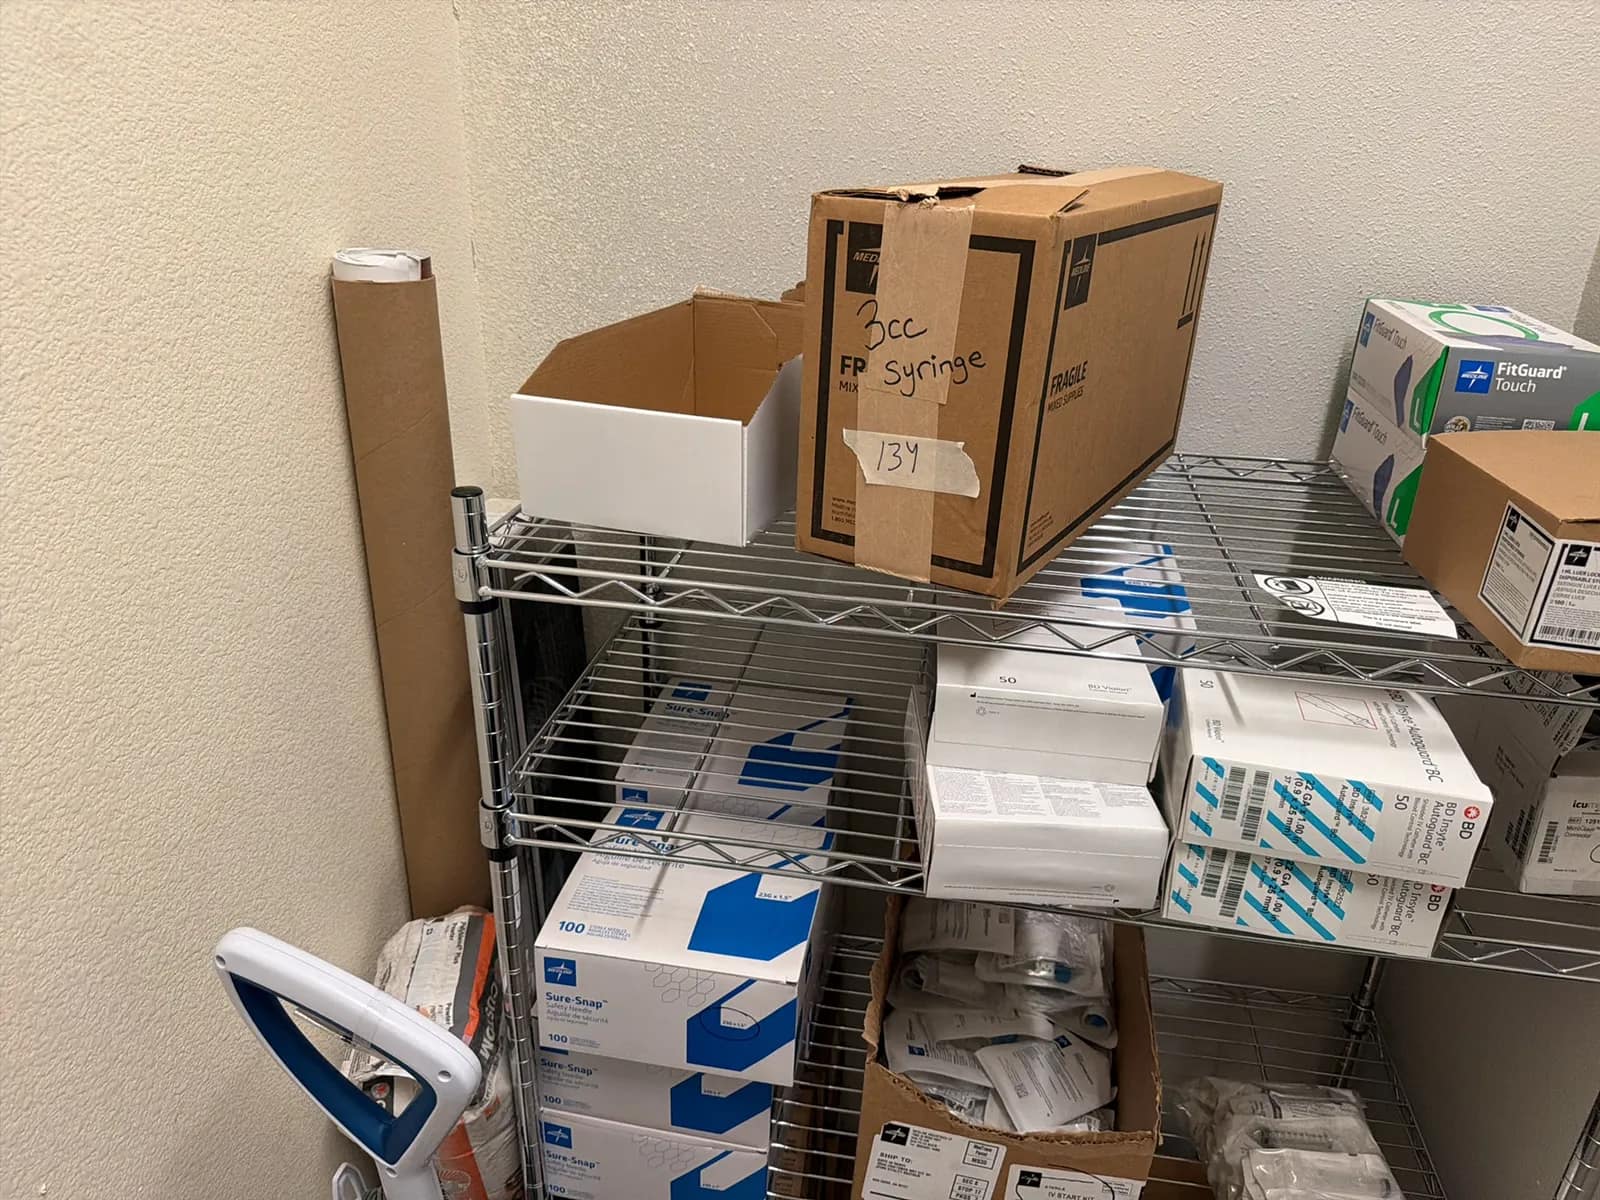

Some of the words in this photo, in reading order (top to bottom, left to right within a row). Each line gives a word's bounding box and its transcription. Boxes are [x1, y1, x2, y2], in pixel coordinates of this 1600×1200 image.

[856, 299, 928, 351] 3cc
[1050, 360, 1088, 397] FRAGILE
[1495, 377, 1537, 393] Touch
[839, 380, 859, 393] MIX
[1000, 676, 1017, 684] 50
[1302, 793, 1313, 807] GA
[1395, 794, 1409, 810] 50
[1445, 801, 1457, 816] BD
[1295, 818, 1306, 835] 1.00
[1459, 821, 1476, 840] BD
[1417, 852, 1431, 865] BC
[1282, 873, 1292, 886] GA
[1427, 894, 1442, 911] BD
[559, 920, 585, 934] 100
[1388, 925, 1400, 937] BC
[480, 981, 499, 1060] CUSTOM
[548, 1033, 568, 1043] 100
[544, 1095, 561, 1104] 100
[880, 1152, 898, 1160] SHIP
[549, 1184, 566, 1193] 100
